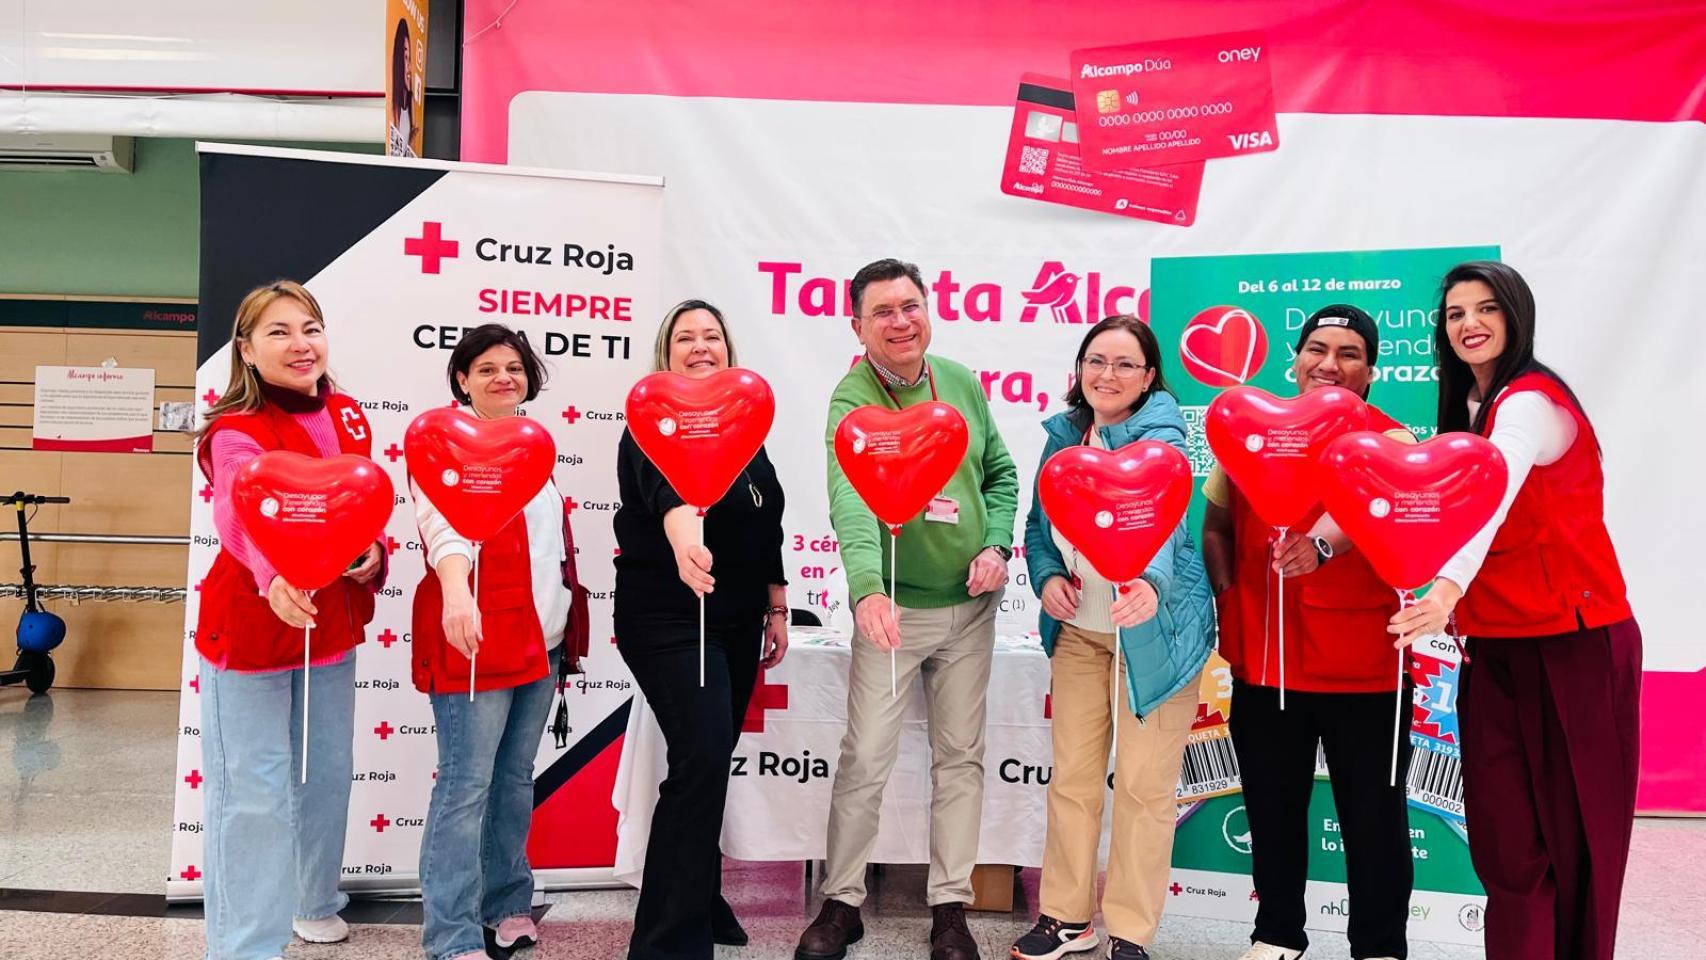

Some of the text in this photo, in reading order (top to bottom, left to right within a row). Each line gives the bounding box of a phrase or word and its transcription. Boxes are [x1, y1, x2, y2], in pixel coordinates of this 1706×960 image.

[1218, 47, 1261, 64] oney
[1081, 57, 1171, 79] Alcampo Dúa
[1099, 102, 1233, 127] 0000 0000 0000 0000
[1133, 141, 1167, 152] APELLIDO
[1167, 137, 1201, 148] APELLIDO
[1229, 131, 1273, 149] VISA
[475, 238, 634, 275] Cruz Roja
[1238, 277, 1401, 293] Del 6 al 12 de marzo
[478, 288, 632, 322] SIEMPRE
[545, 331, 591, 357] DE
[601, 335, 630, 359] TI
[354, 399, 409, 412] ruz Roja
[586, 411, 613, 420] Cruz
[557, 454, 583, 465] Roja
[583, 501, 610, 511] Cruz
[193, 535, 219, 547] Roja
[793, 534, 805, 551] 3
[801, 566, 824, 579] en
[587, 591, 606, 599] ruz
[1430, 639, 1457, 654] con
[372, 678, 400, 690] Roja
[605, 679, 631, 691] Roja
[399, 725, 427, 735] Cruz
[1188, 729, 1221, 742] QUETA
[759, 750, 829, 783] Roja
[1000, 758, 1053, 785] Cru
[369, 770, 396, 783] Roja
[1191, 780, 1228, 795] 831929
[1422, 793, 1462, 813] 000002
[396, 817, 424, 827] Cruz
[1321, 837, 1337, 851] lo
[342, 863, 392, 875] ruz Roja
[1186, 886, 1227, 898] Cruz Roja
